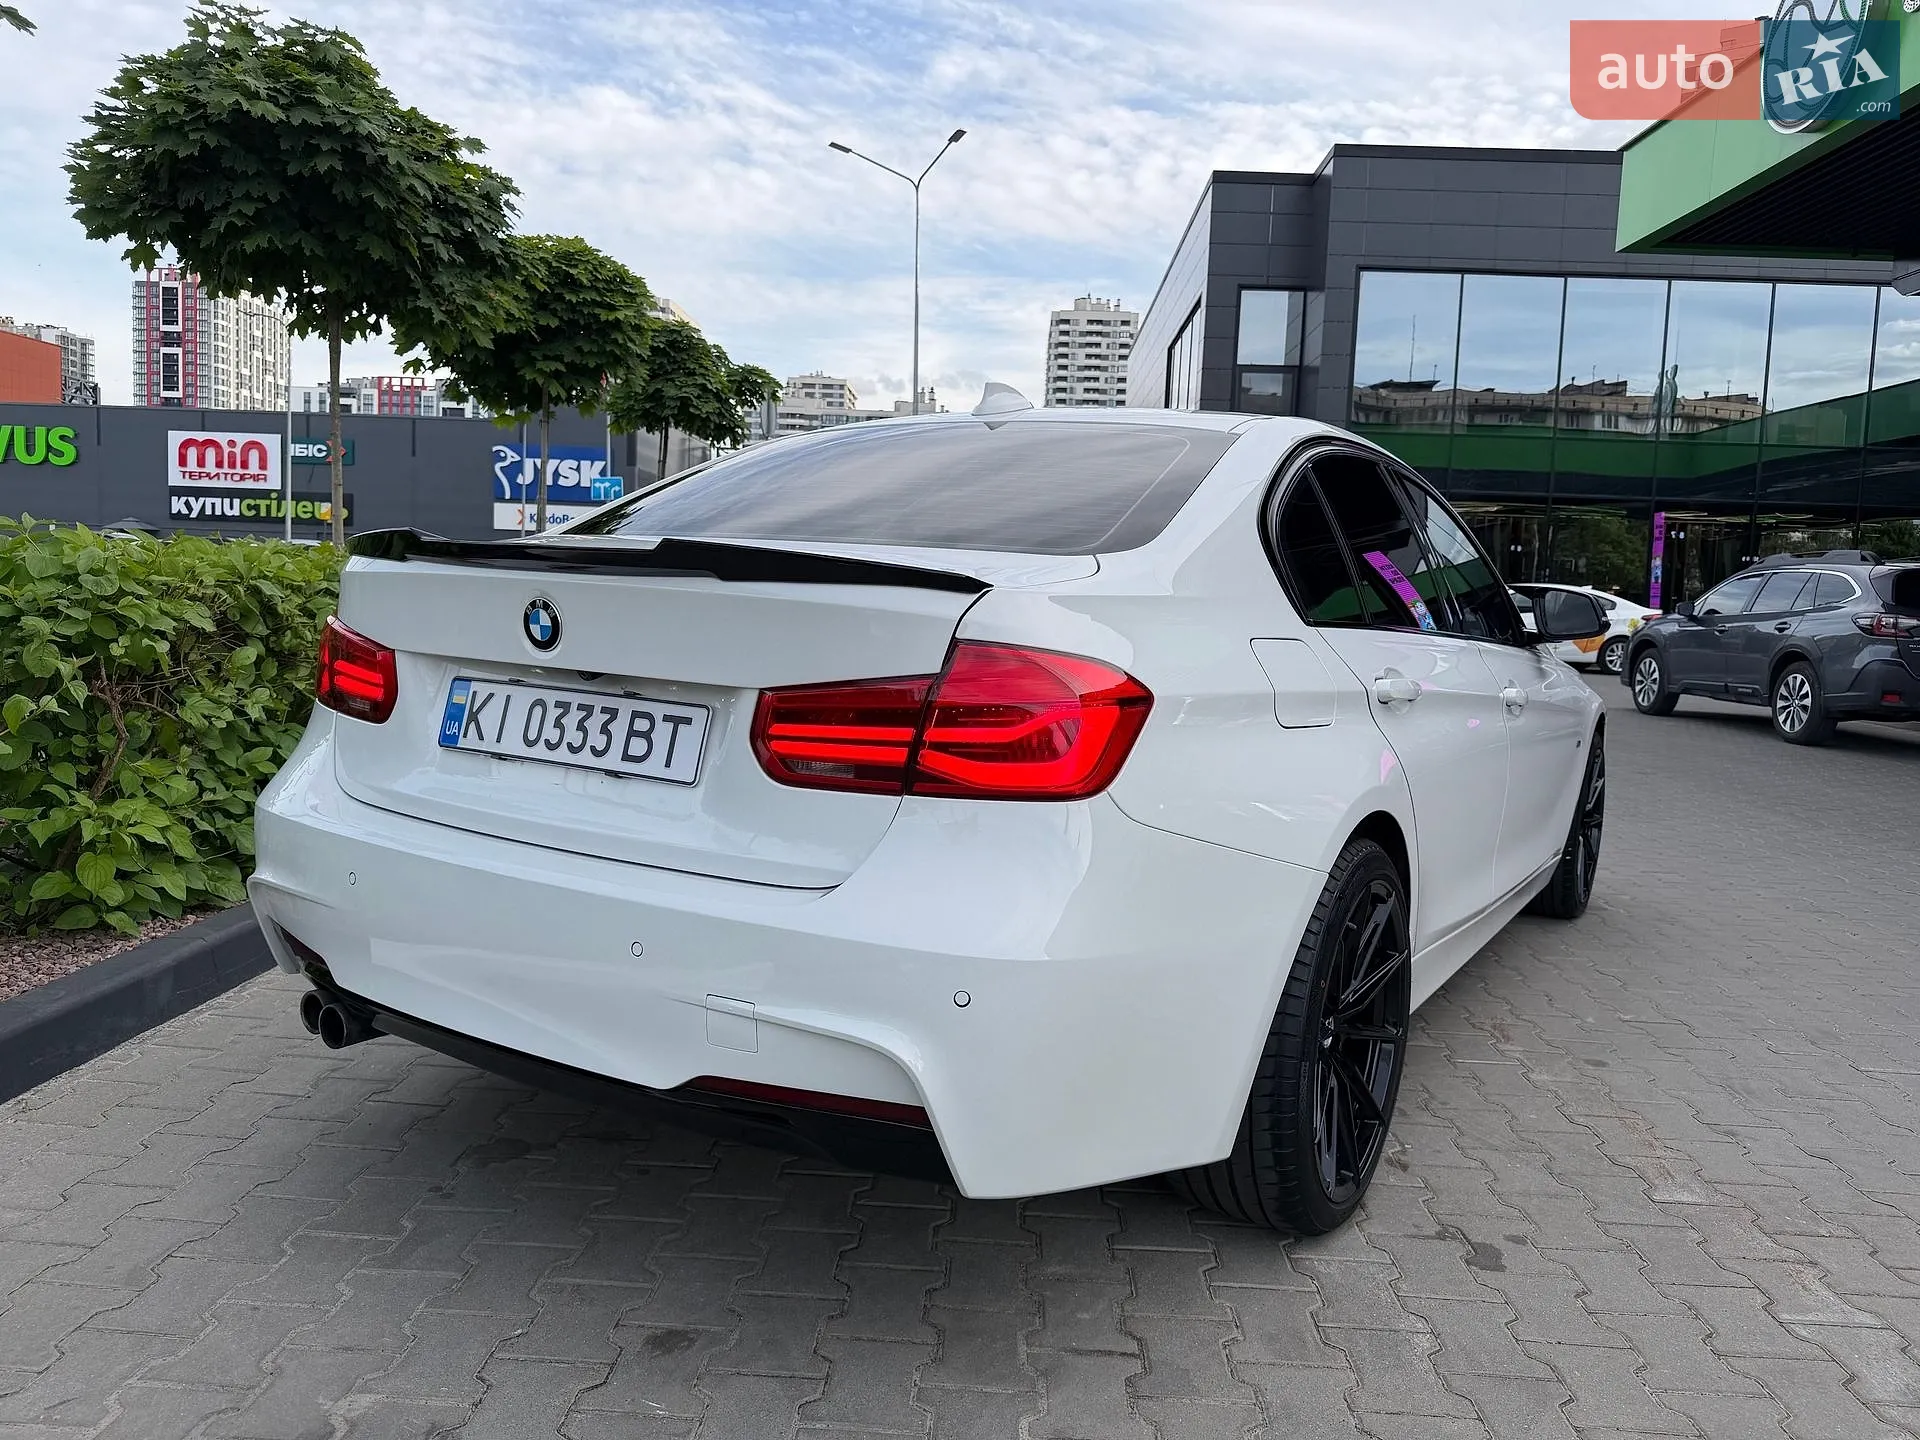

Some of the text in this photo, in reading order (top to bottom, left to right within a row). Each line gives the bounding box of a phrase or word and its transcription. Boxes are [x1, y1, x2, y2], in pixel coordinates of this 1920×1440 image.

[178, 437, 268, 471] min
[178, 470, 268, 483] ТЕРИТОРІЯ
[516, 457, 607, 488] JYSK
[170, 491, 349, 524] купистіле
[526, 599, 556, 618] BMW
[445, 719, 460, 737] UA
